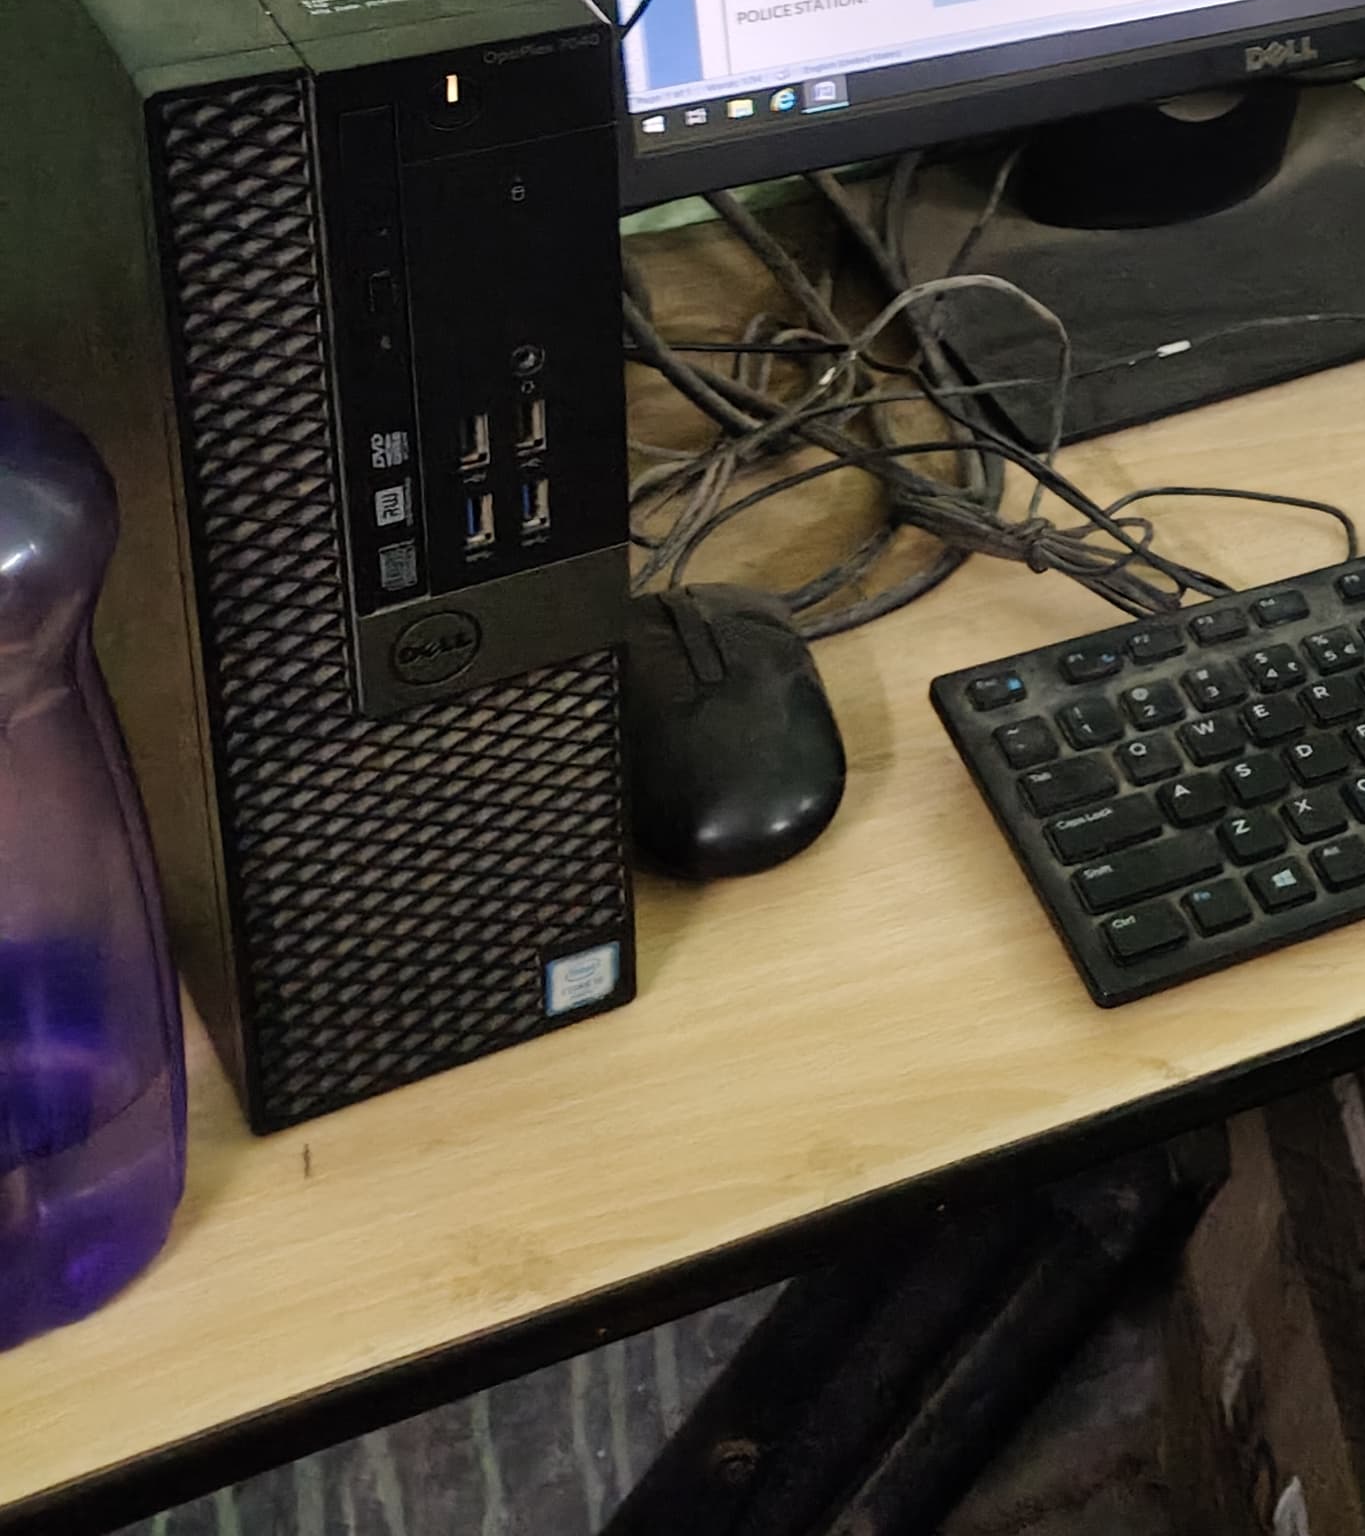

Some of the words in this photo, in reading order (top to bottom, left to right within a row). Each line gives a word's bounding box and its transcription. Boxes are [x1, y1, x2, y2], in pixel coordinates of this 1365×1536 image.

[736, 2, 792, 26] POLICE
[1245, 36, 1318, 72] DELL
[1192, 720, 1215, 736] W
